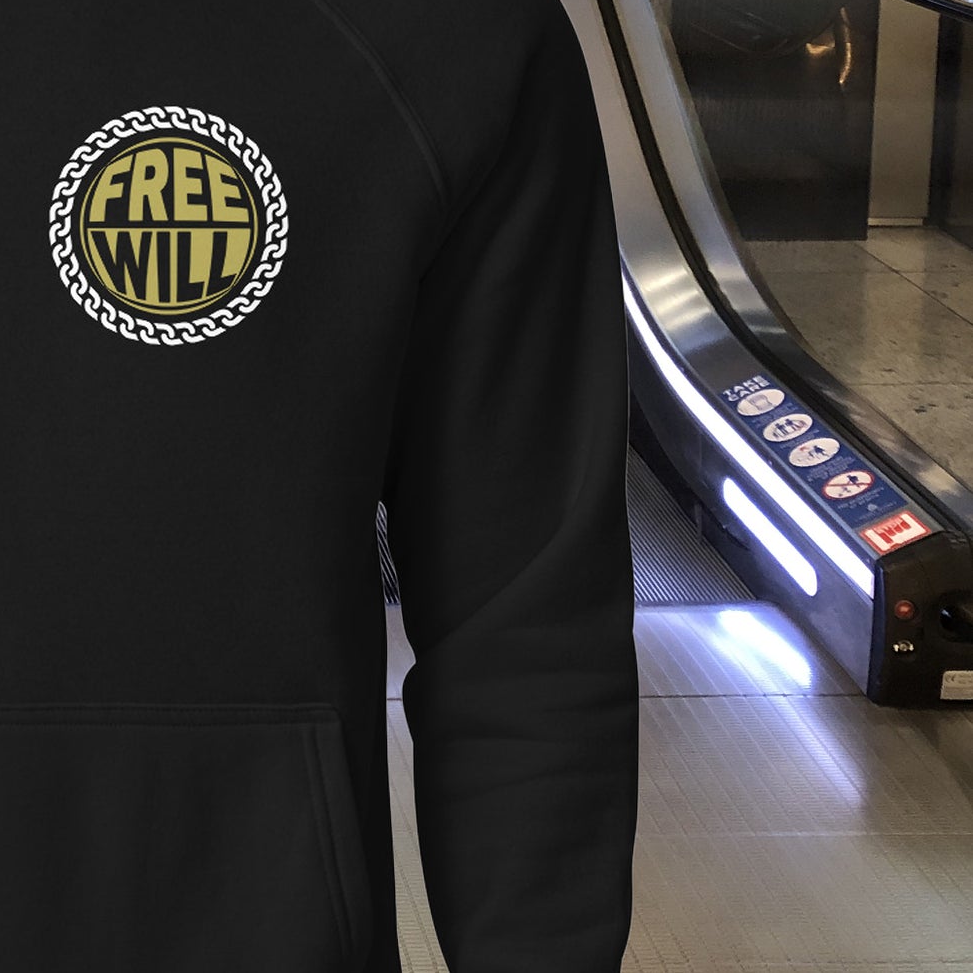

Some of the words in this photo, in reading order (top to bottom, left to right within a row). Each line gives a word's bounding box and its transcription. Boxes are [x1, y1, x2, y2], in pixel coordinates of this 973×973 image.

[89, 148, 249, 222] FREE
[90, 231, 238, 303] WILL
[723, 375, 763, 397] TAKE
